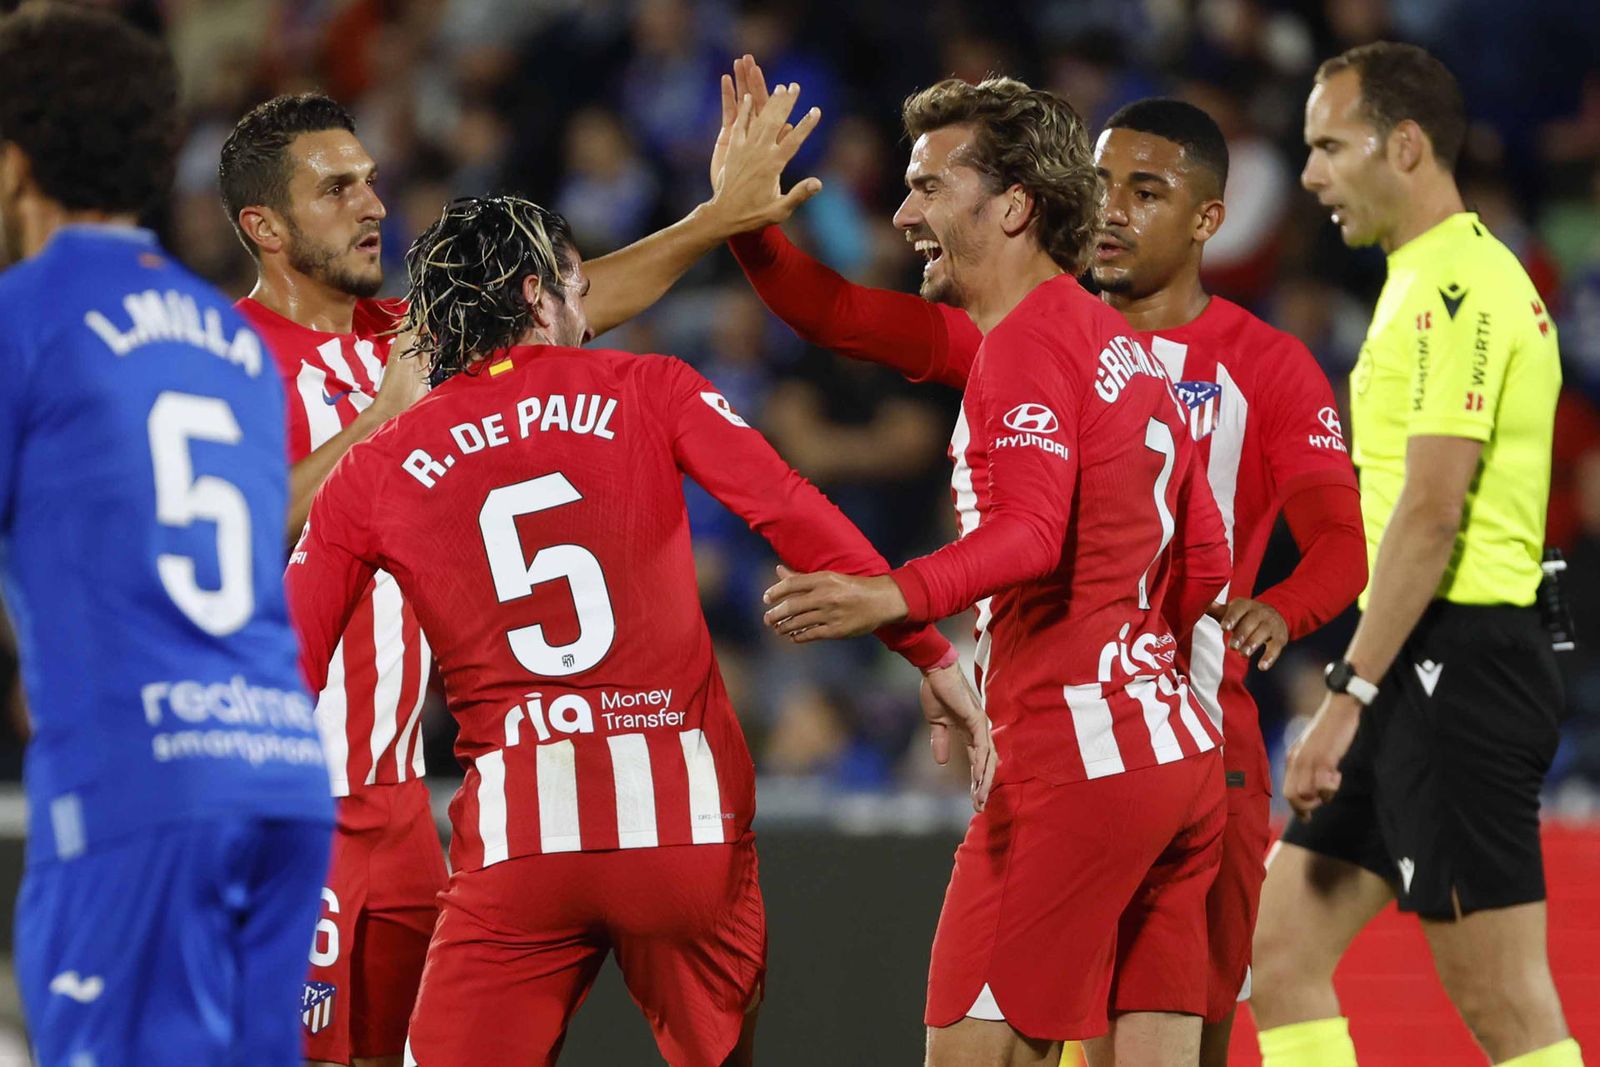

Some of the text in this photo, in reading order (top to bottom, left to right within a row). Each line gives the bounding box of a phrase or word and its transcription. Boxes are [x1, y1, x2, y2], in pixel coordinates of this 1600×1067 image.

[401, 393, 618, 489] R. DE PAUL
[995, 432, 1069, 461] HYUNDAI
[147, 390, 253, 637] 5
[478, 470, 616, 677] 5
[504, 688, 673, 748] ria Money
[601, 710, 686, 731] Transfer
[308, 886, 341, 968] 6
